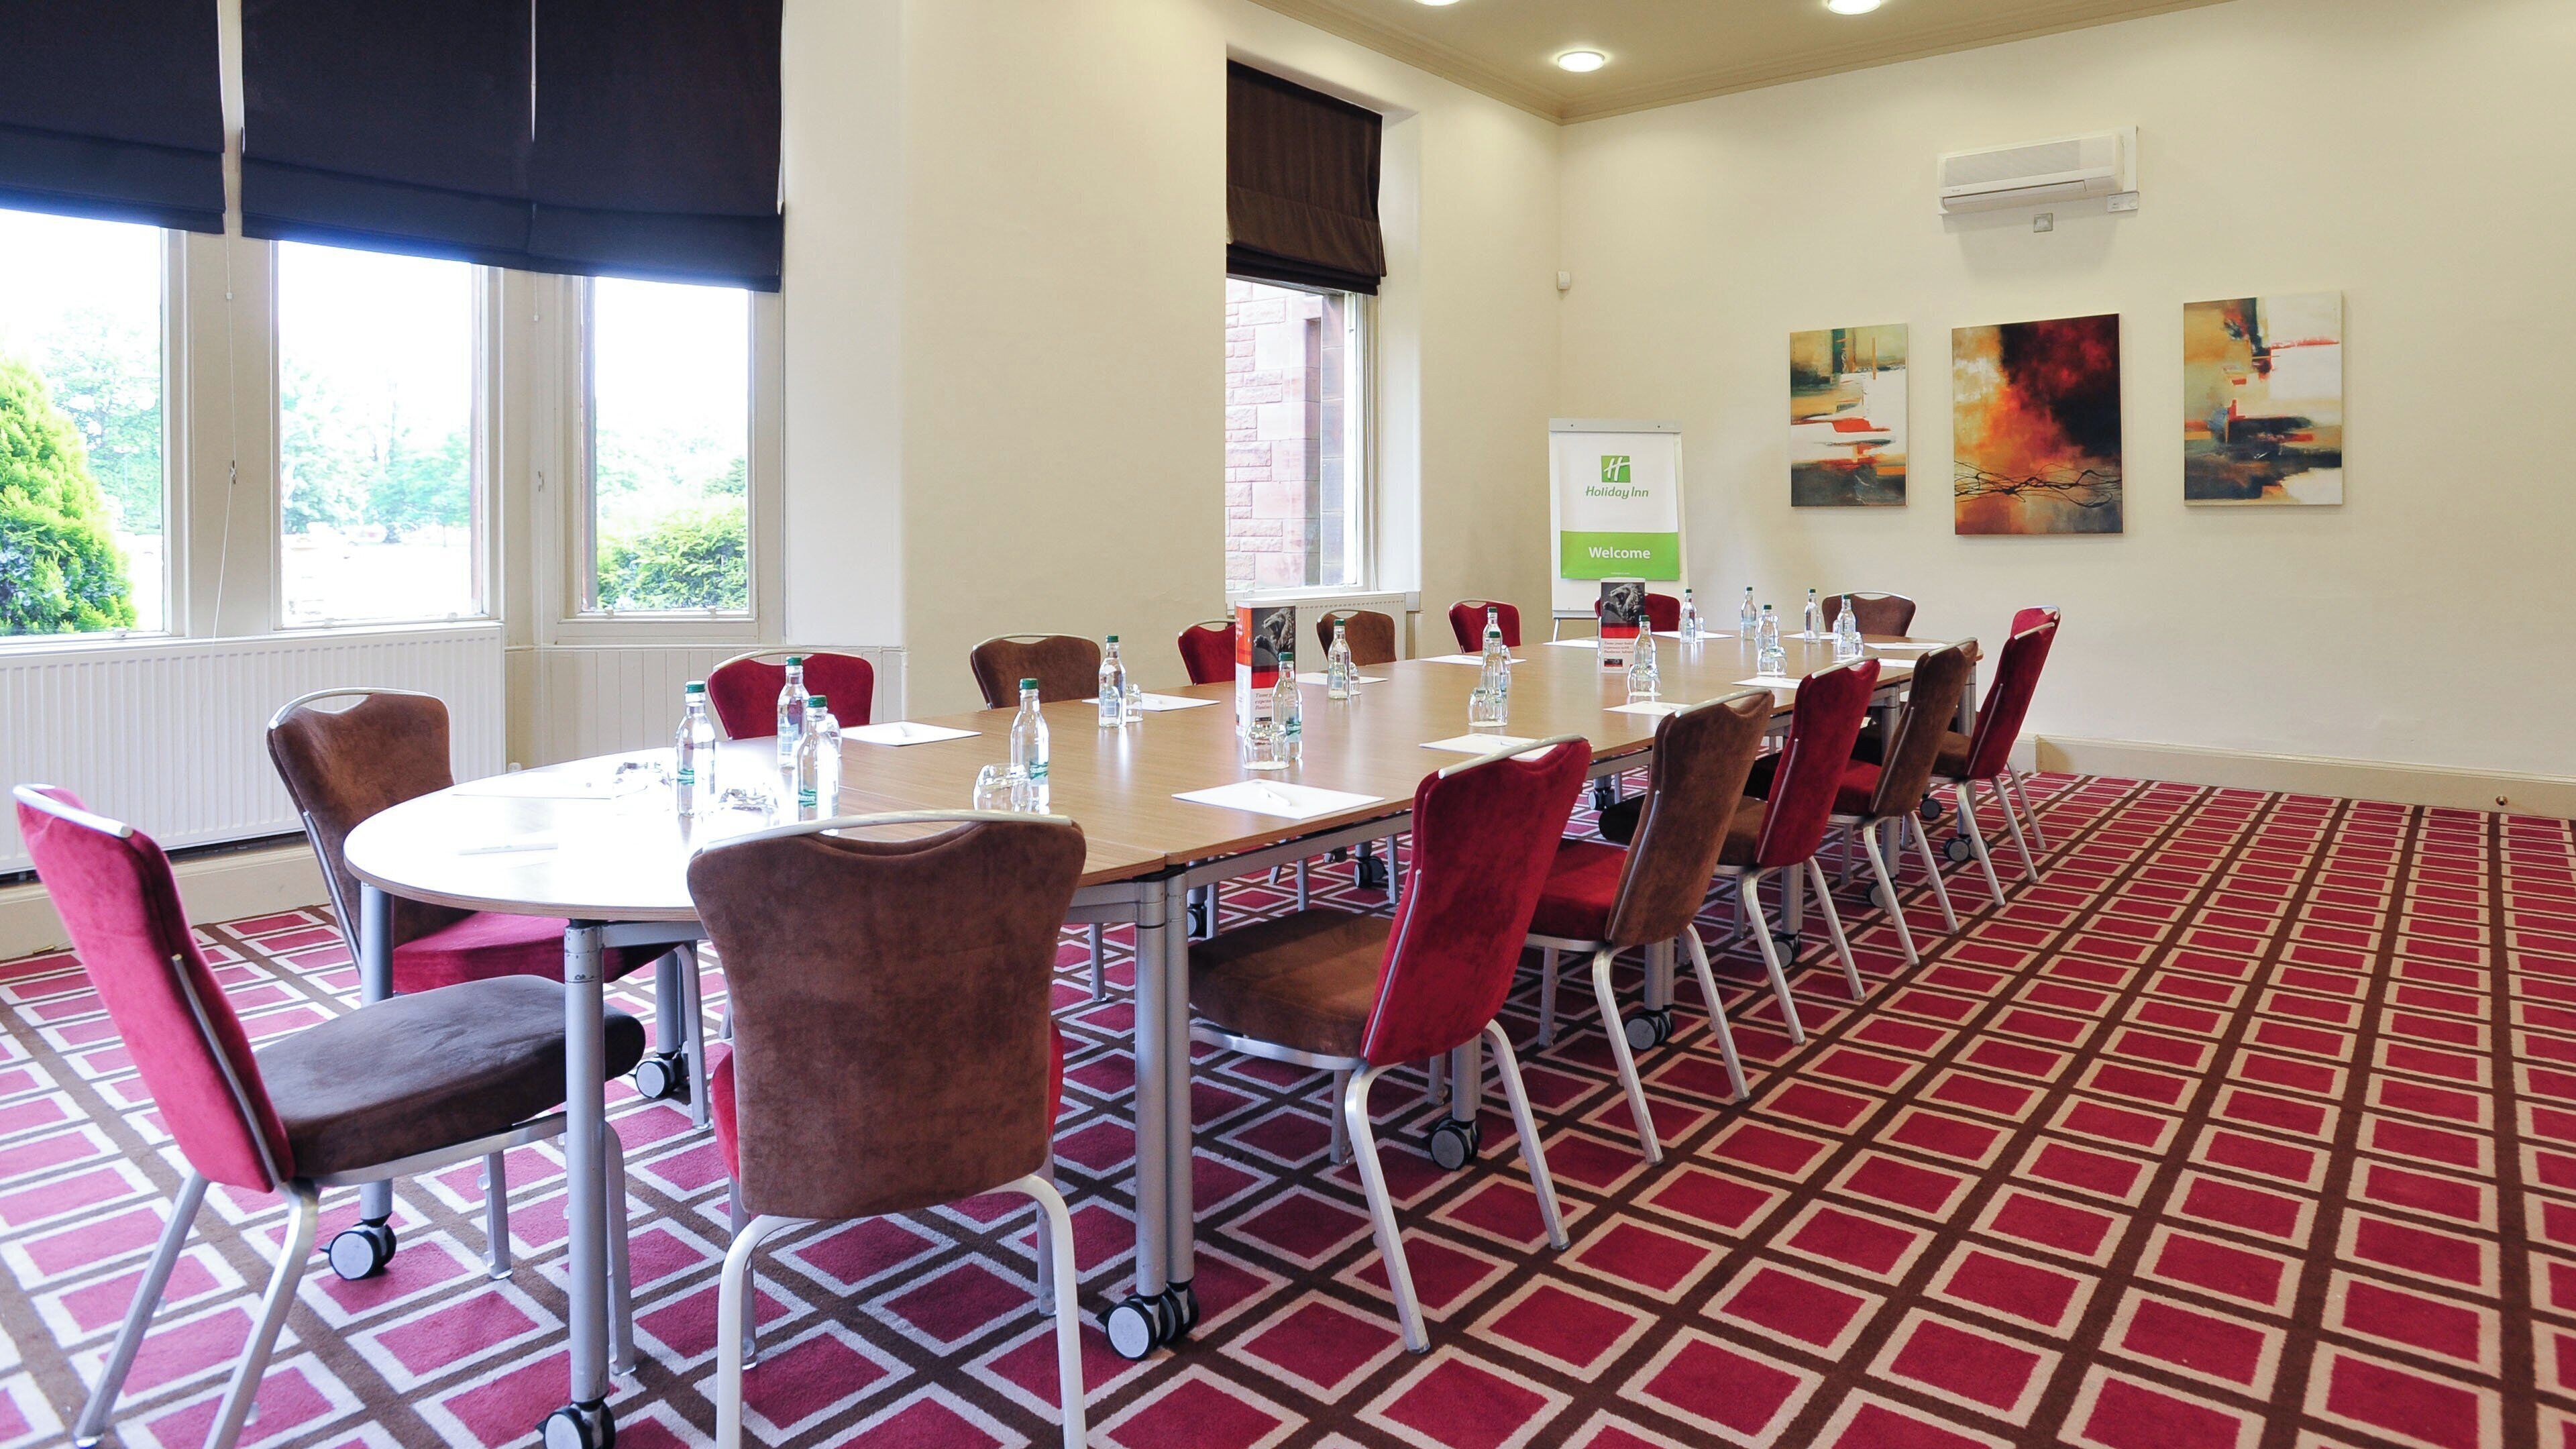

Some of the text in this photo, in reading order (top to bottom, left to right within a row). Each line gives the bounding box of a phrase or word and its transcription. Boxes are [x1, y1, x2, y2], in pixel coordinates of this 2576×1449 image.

[1586, 485, 1649, 499] Holiday Inn
[1588, 546, 1651, 559] Welcome
